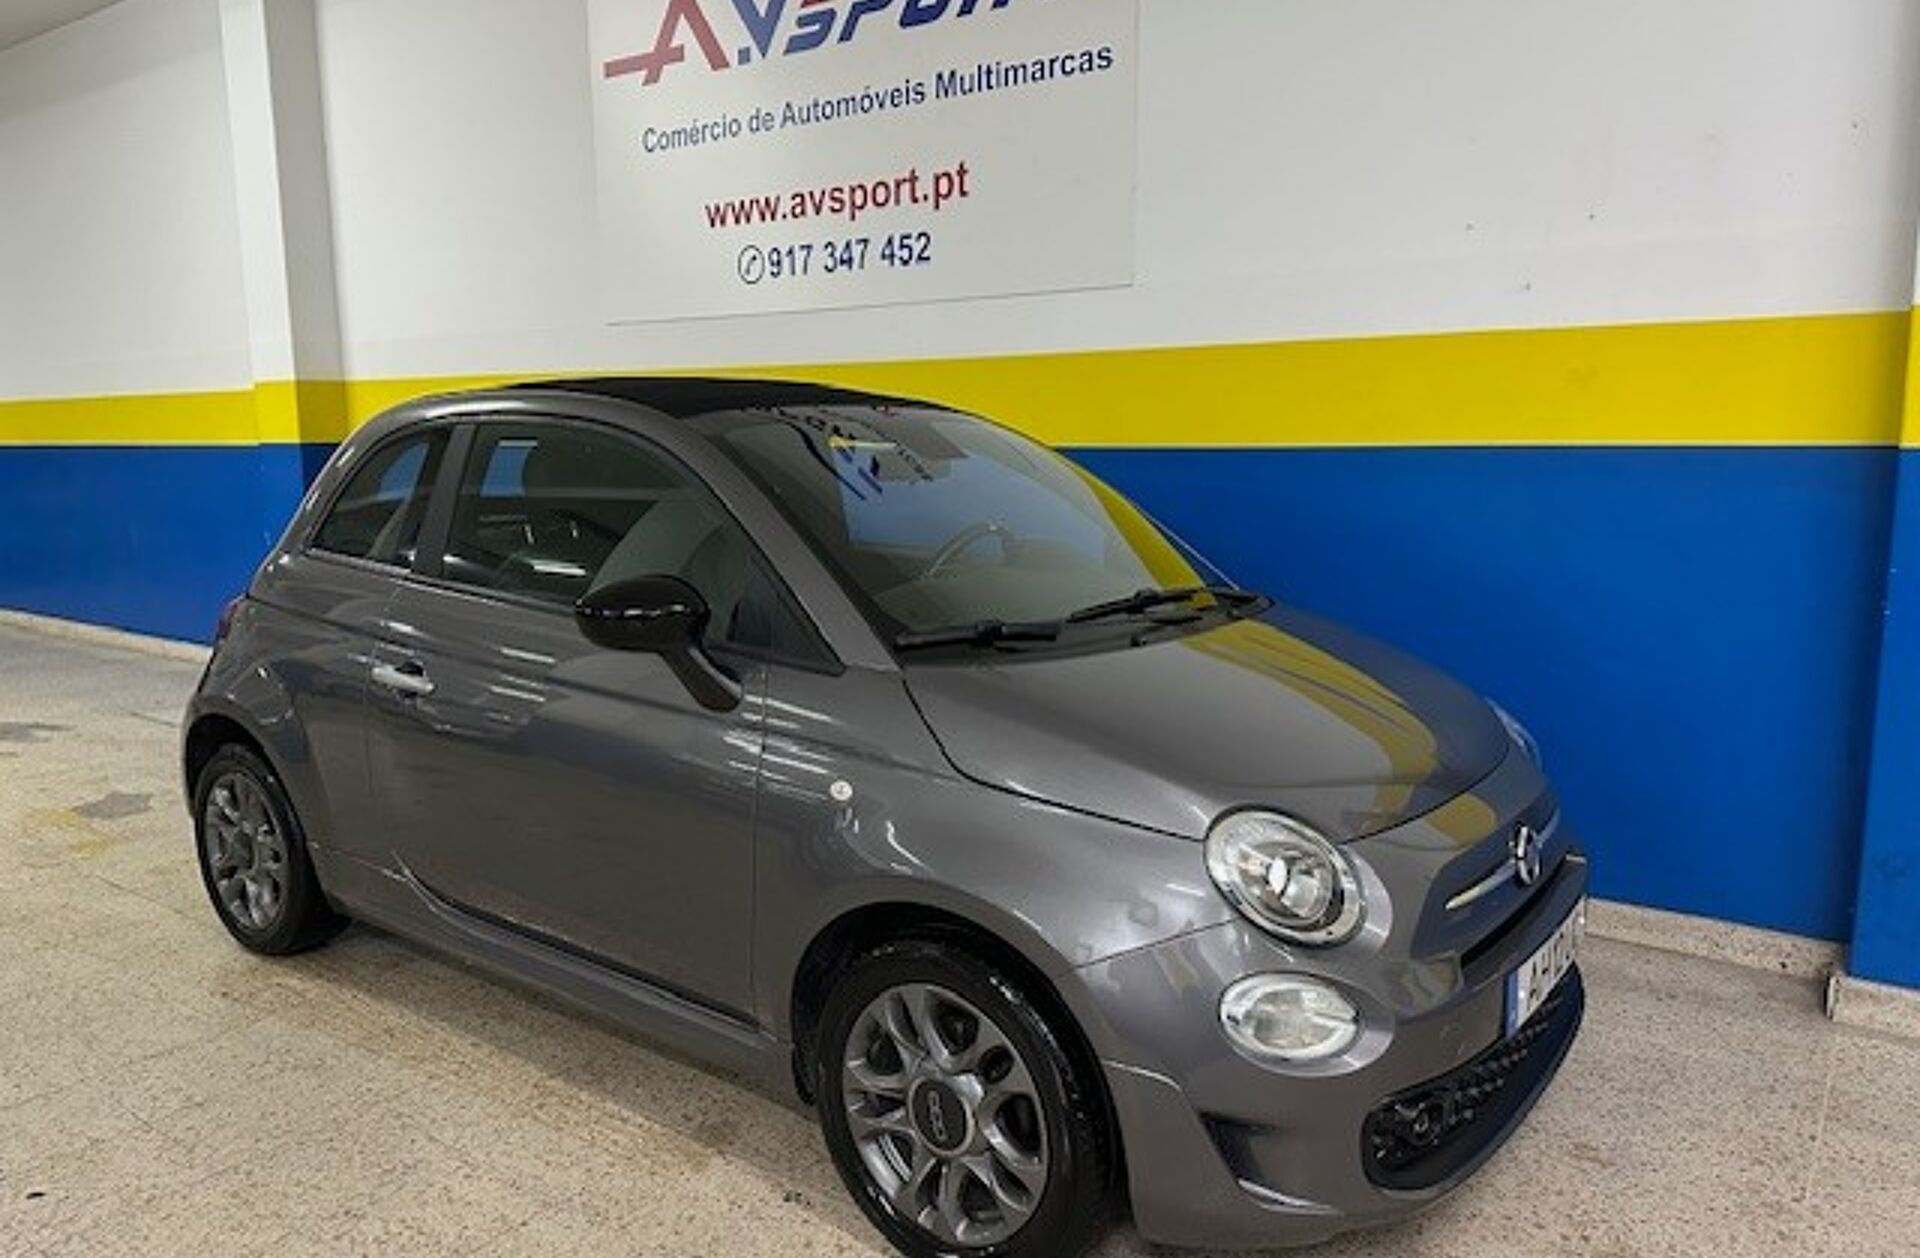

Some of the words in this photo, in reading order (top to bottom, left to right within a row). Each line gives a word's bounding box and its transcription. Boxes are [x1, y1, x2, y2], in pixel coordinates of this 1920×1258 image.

[642, 113, 742, 153] Comércio
[749, 107, 775, 134] de
[780, 79, 926, 129] Automóveis
[935, 46, 1114, 100] Multimarcas
[705, 161, 969, 228] www.avsport.pt
[767, 244, 814, 279] 917
[823, 238, 870, 273] 347
[880, 232, 932, 268] 452
